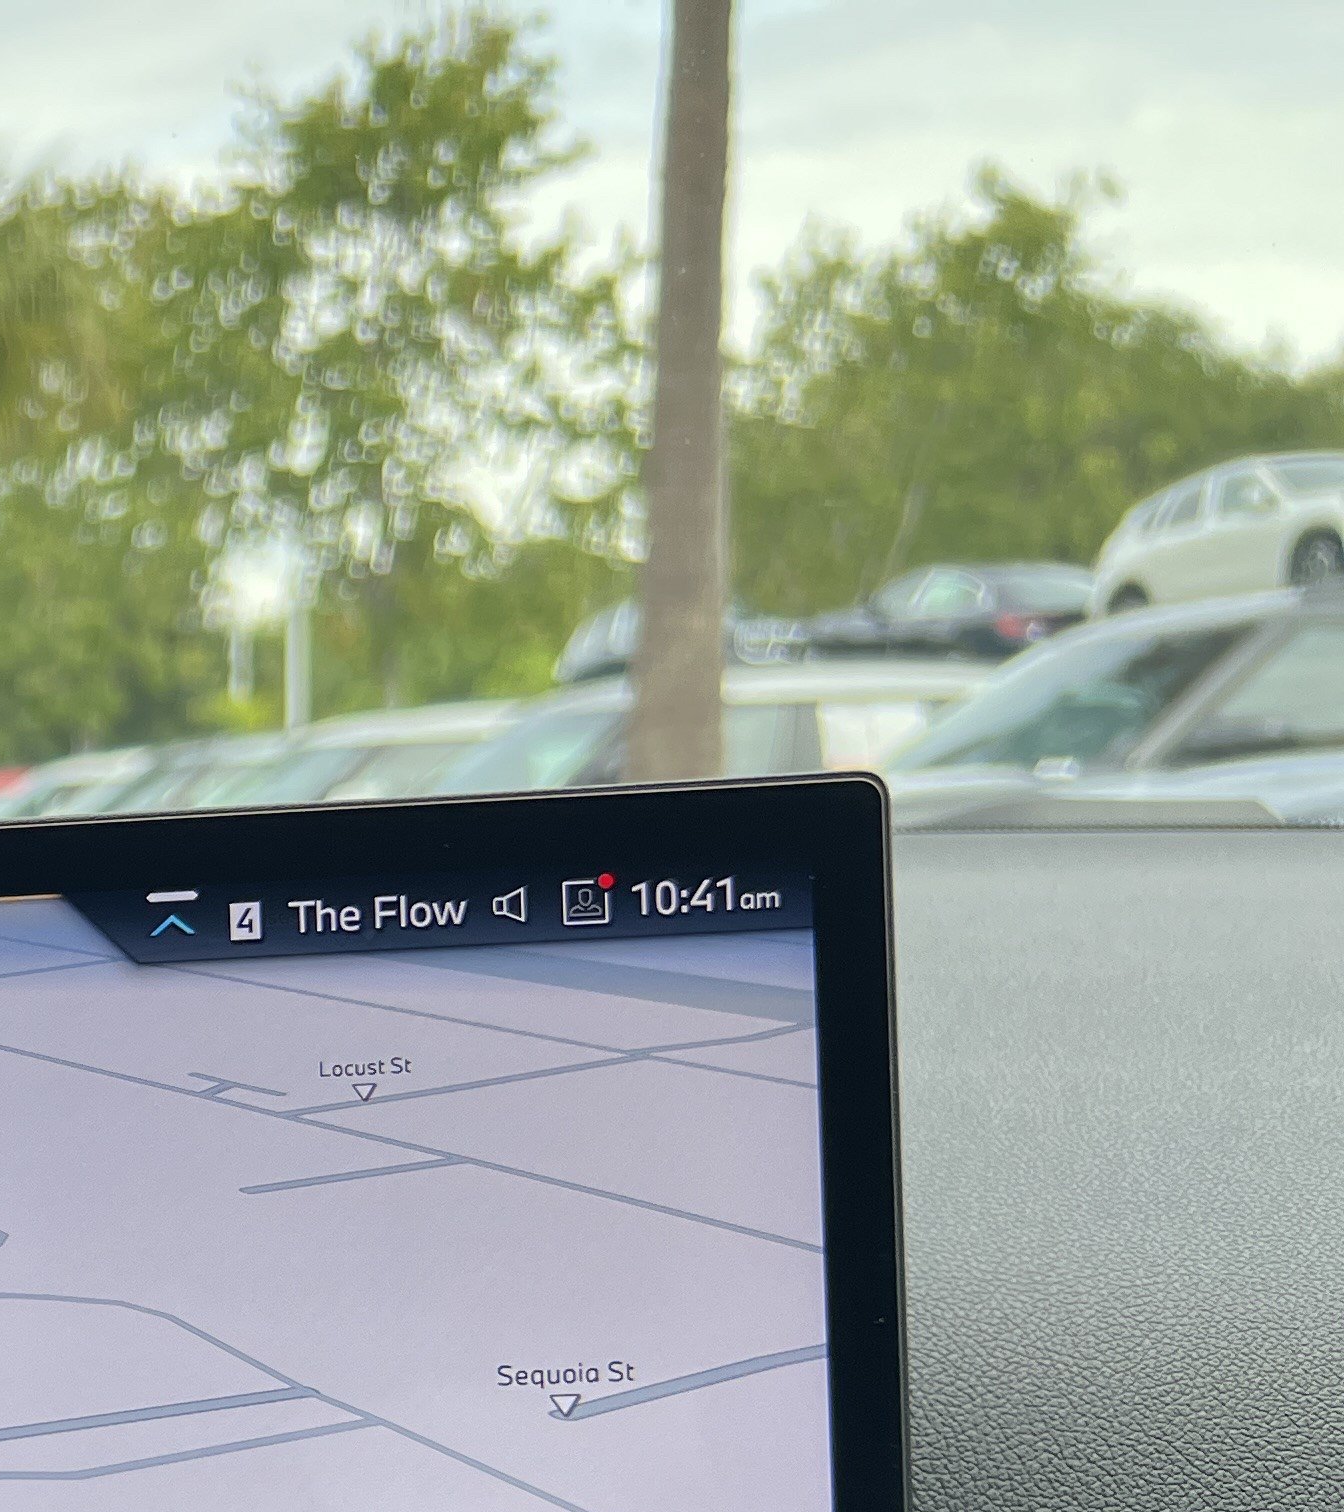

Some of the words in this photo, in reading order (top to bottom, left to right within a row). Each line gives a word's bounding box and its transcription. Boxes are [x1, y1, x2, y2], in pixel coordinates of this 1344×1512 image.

[287, 900, 361, 933] The
[374, 895, 467, 929] Flow
[319, 1060, 385, 1077] Locust
[390, 1057, 412, 1074] St
[497, 1362, 600, 1389] Sequoia
[608, 1360, 635, 1382] St
